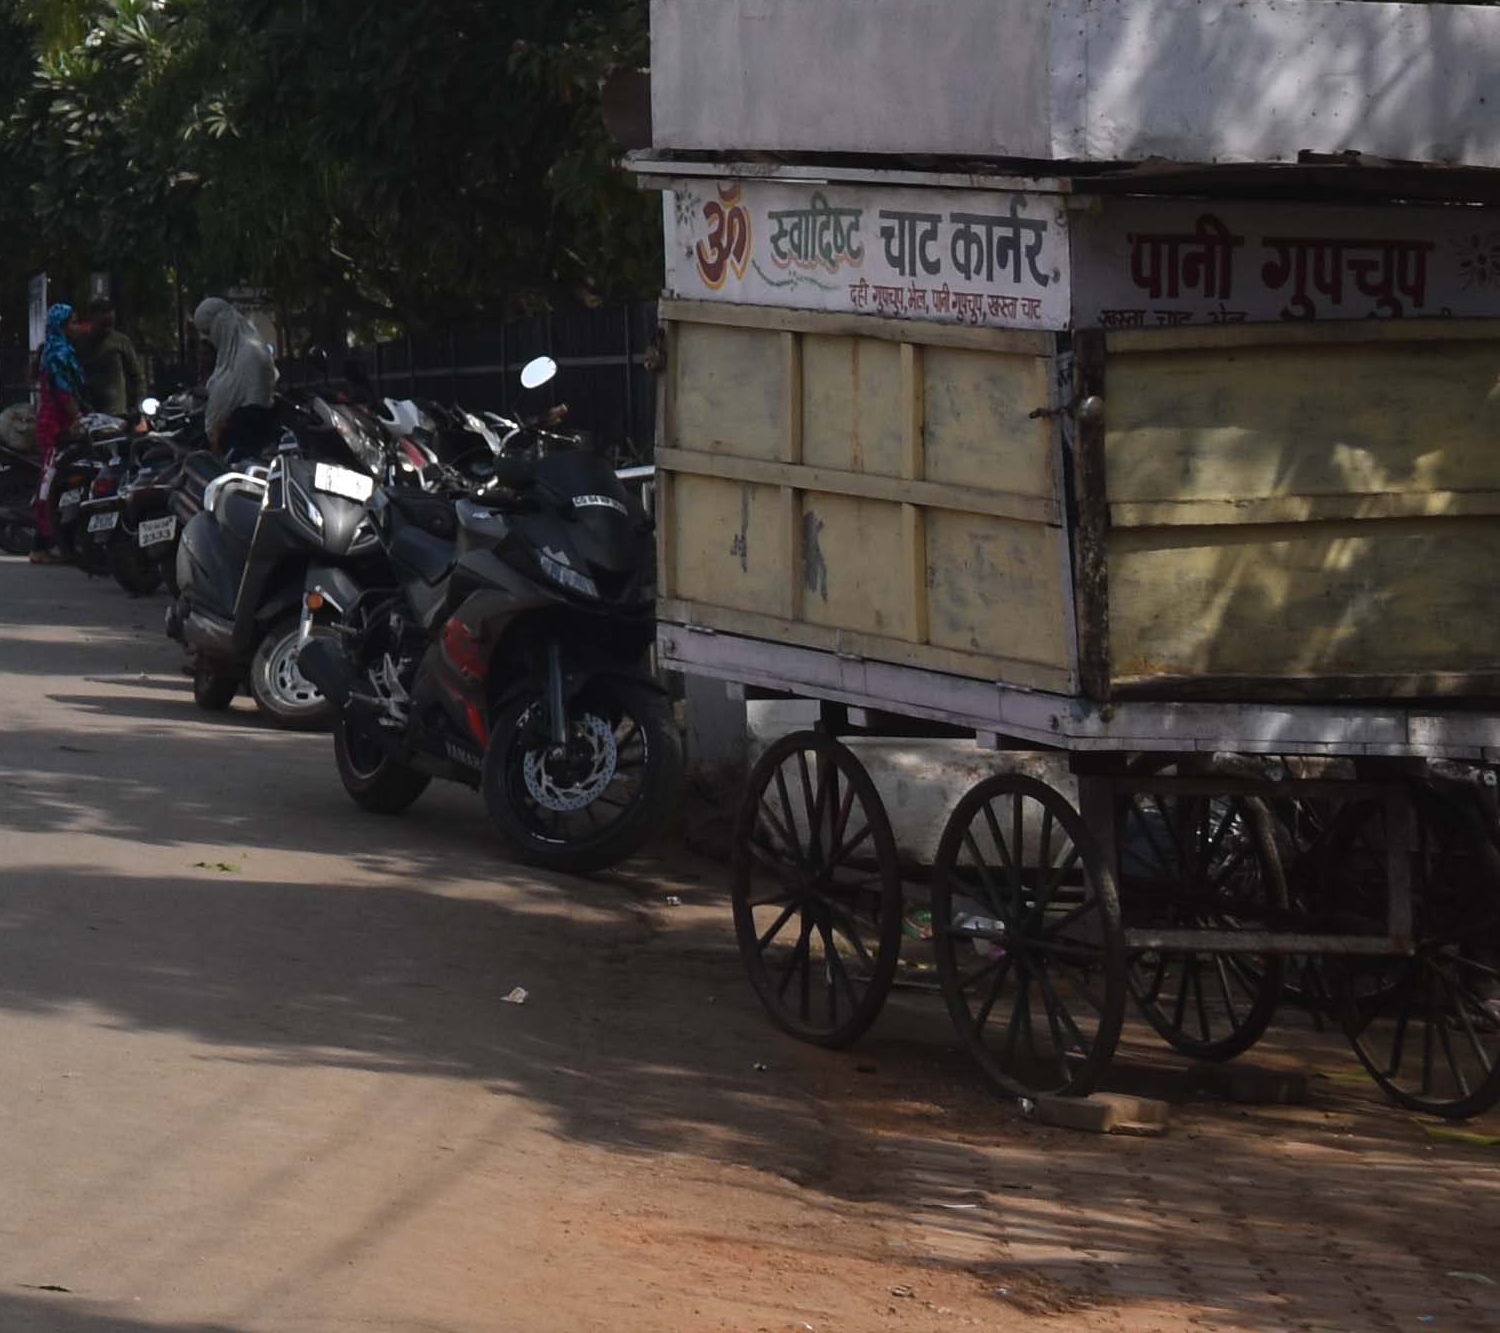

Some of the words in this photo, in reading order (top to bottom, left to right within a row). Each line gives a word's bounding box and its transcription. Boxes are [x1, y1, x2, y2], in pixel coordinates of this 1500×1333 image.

[767, 190, 863, 270] स्वादिष्ट
[879, 209, 942, 277] चाट
[950, 194, 1050, 287] कार्नर
[1127, 213, 1244, 299] पानी
[1262, 236, 1435, 321] गुपचुप
[849, 277, 869, 308] दही
[932, 282, 950, 313] पानी
[1021, 297, 1042, 320] चाट
